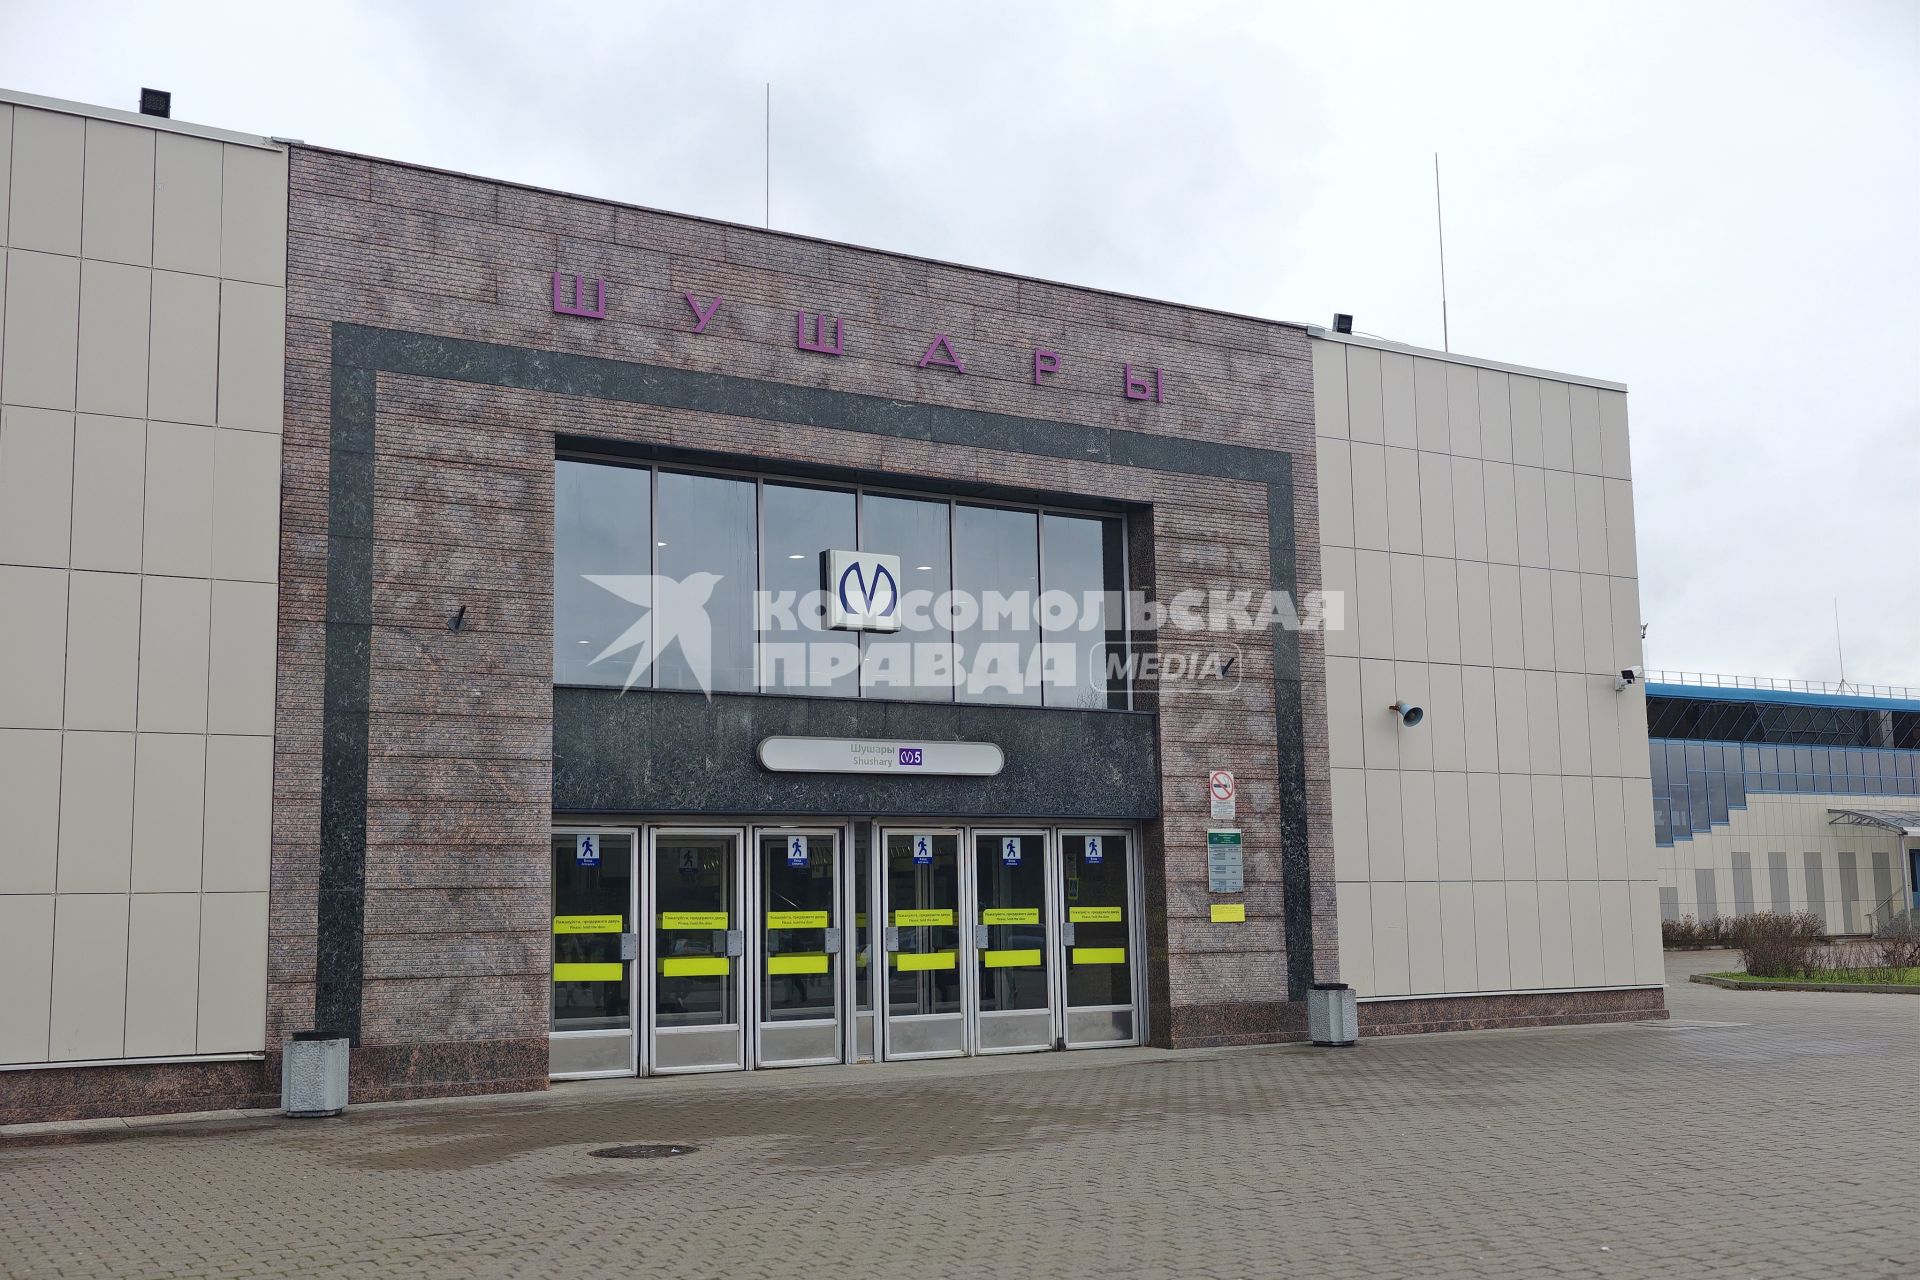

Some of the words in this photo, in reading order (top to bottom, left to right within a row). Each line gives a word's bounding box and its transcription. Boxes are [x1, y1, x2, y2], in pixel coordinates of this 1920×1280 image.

[554, 271, 1163, 403] ШУШАРЫ
[851, 744, 895, 756] Шушары
[853, 757, 893, 768] Shushary
[914, 751, 921, 764] 5
